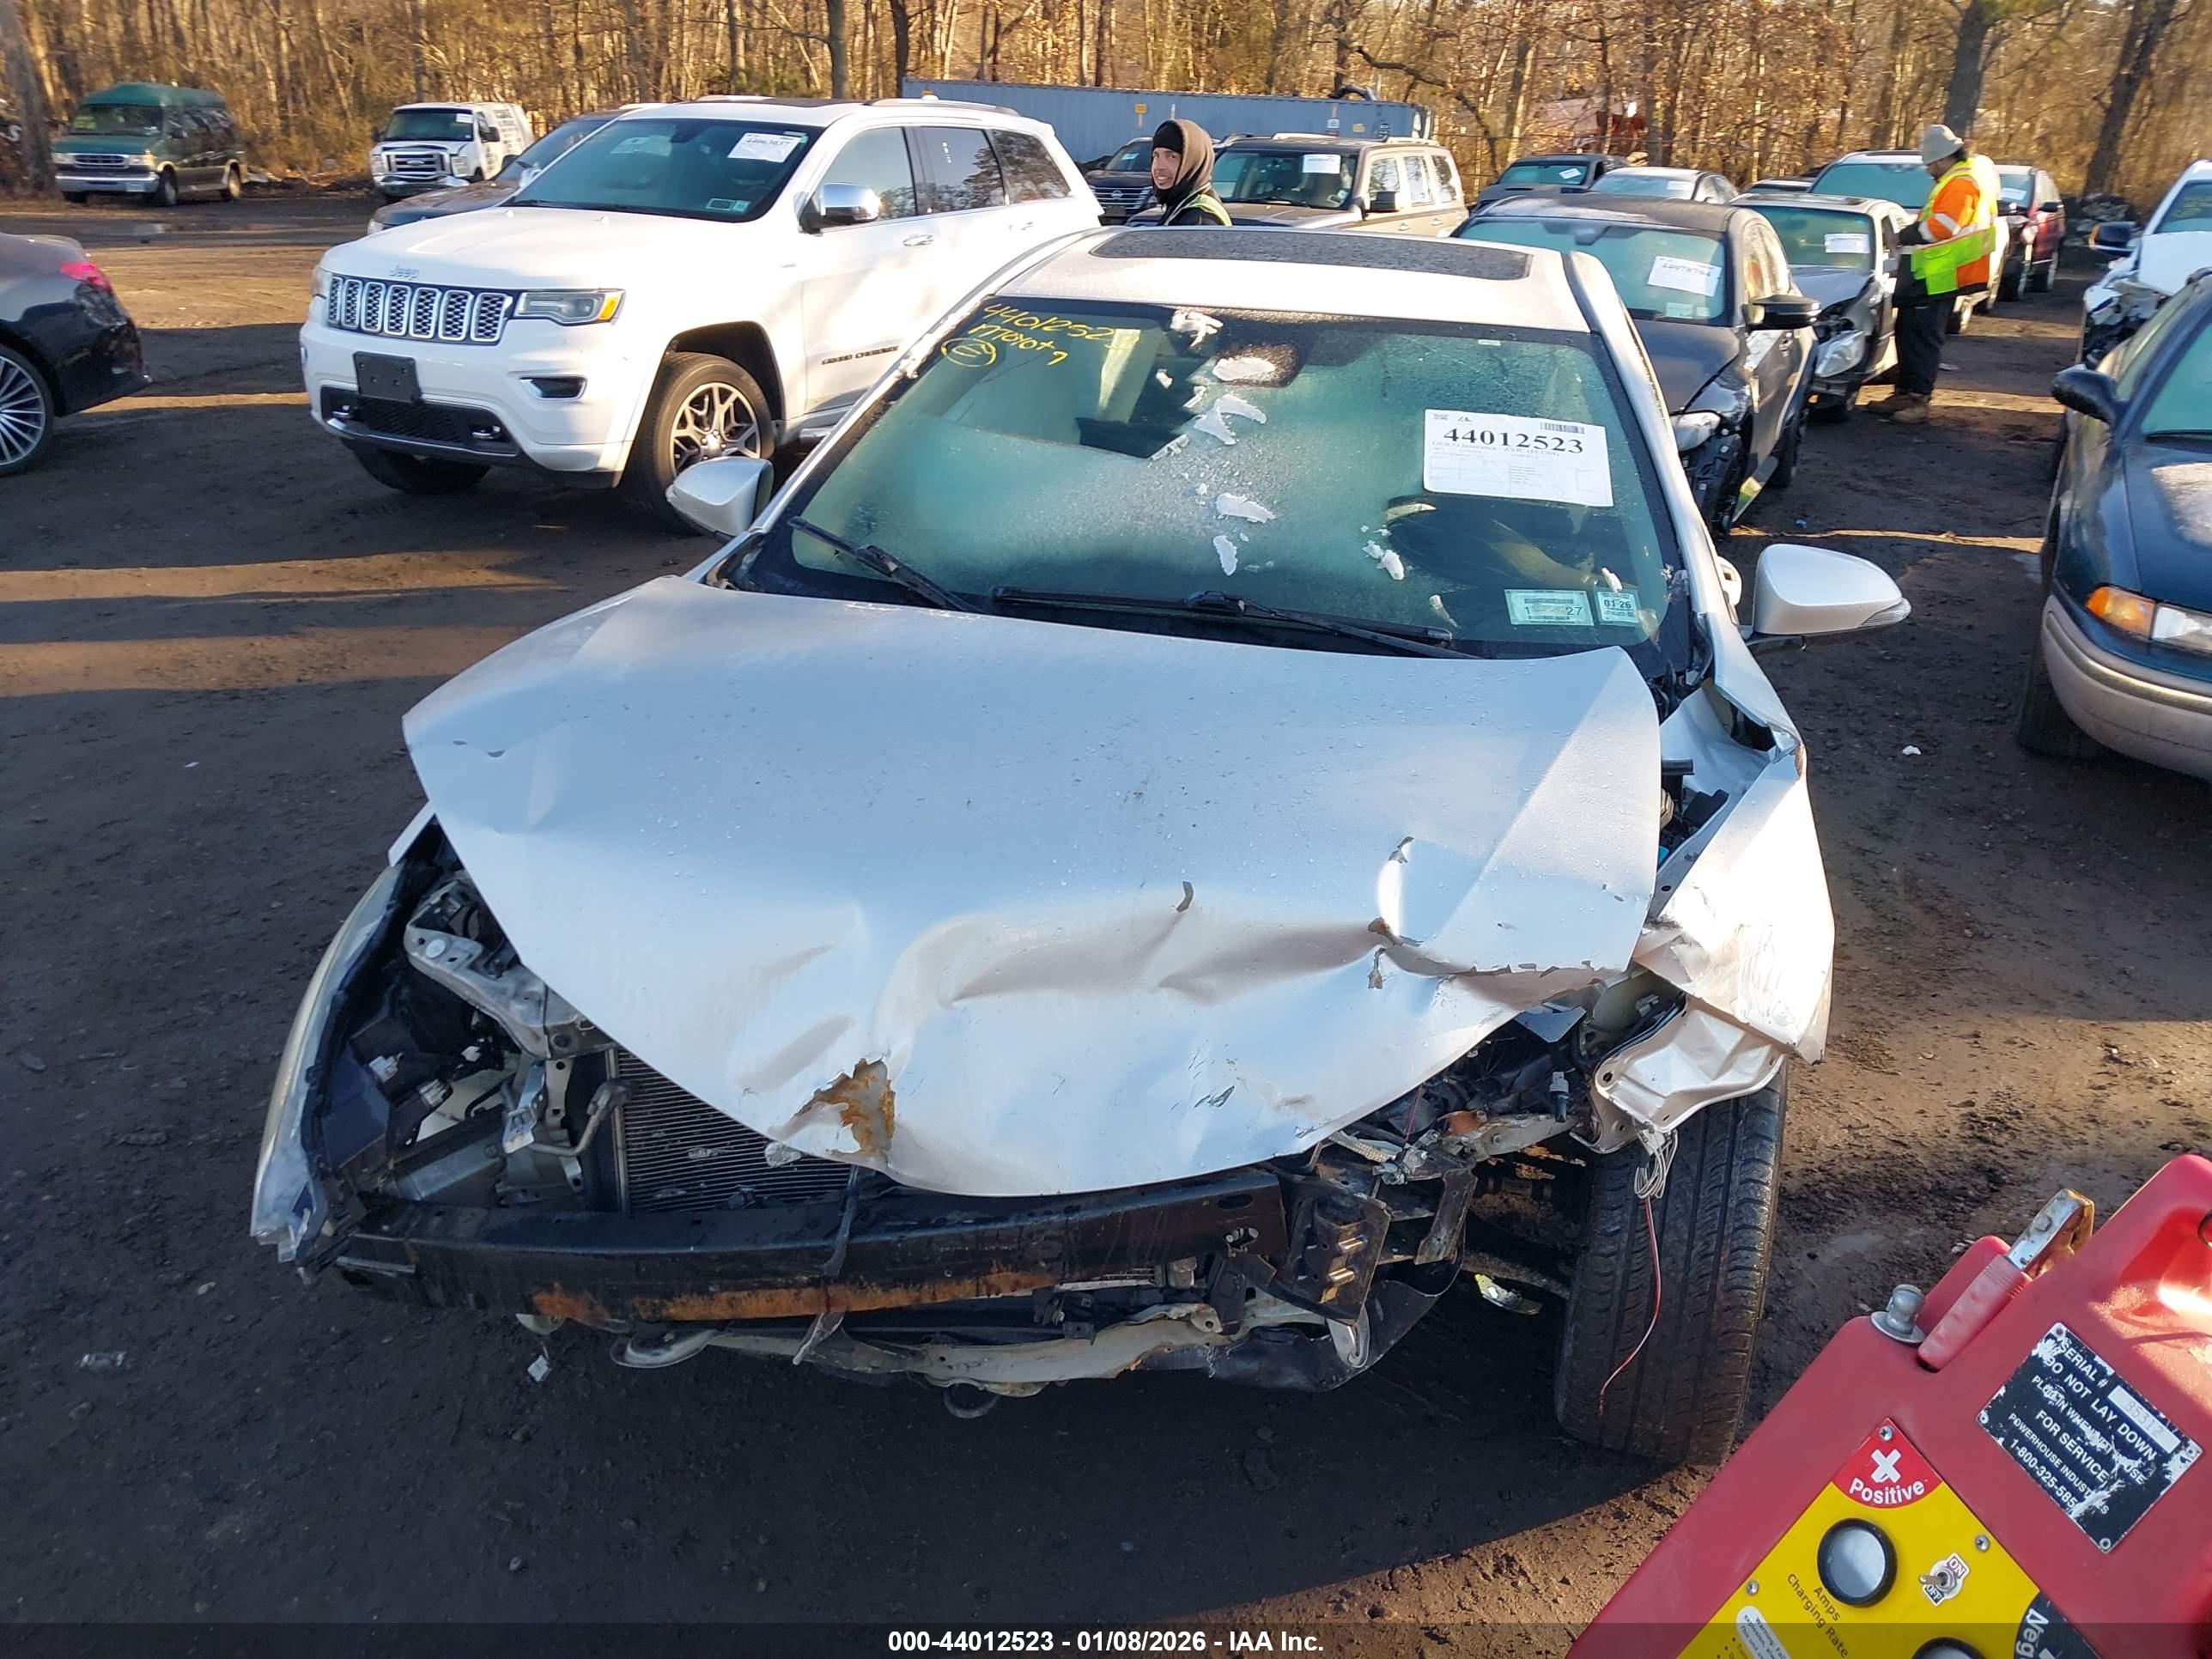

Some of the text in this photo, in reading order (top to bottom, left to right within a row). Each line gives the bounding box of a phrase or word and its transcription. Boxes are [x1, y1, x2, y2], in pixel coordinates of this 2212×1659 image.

[1443, 428, 1583, 454] 44012523
[1565, 606, 1583, 616] 27
[2060, 1340, 2098, 1382] SERIAL
[2063, 1373, 2093, 1399] NOT
[2090, 1398, 2118, 1423] LAY
[2117, 1423, 2158, 1462] DOWN
[2008, 1413, 2063, 1468] POWERHOUSE
[2035, 1409, 2062, 1437] FOR
[2058, 1432, 2110, 1483] SERVICE
[1849, 1477, 1925, 1504] Positive
[1948, 1558, 1966, 1577] ON
[1813, 1586, 1841, 1621] Amps
[1926, 1584, 1943, 1602] OFF
[1787, 1573, 1848, 1659] Charging Rate
